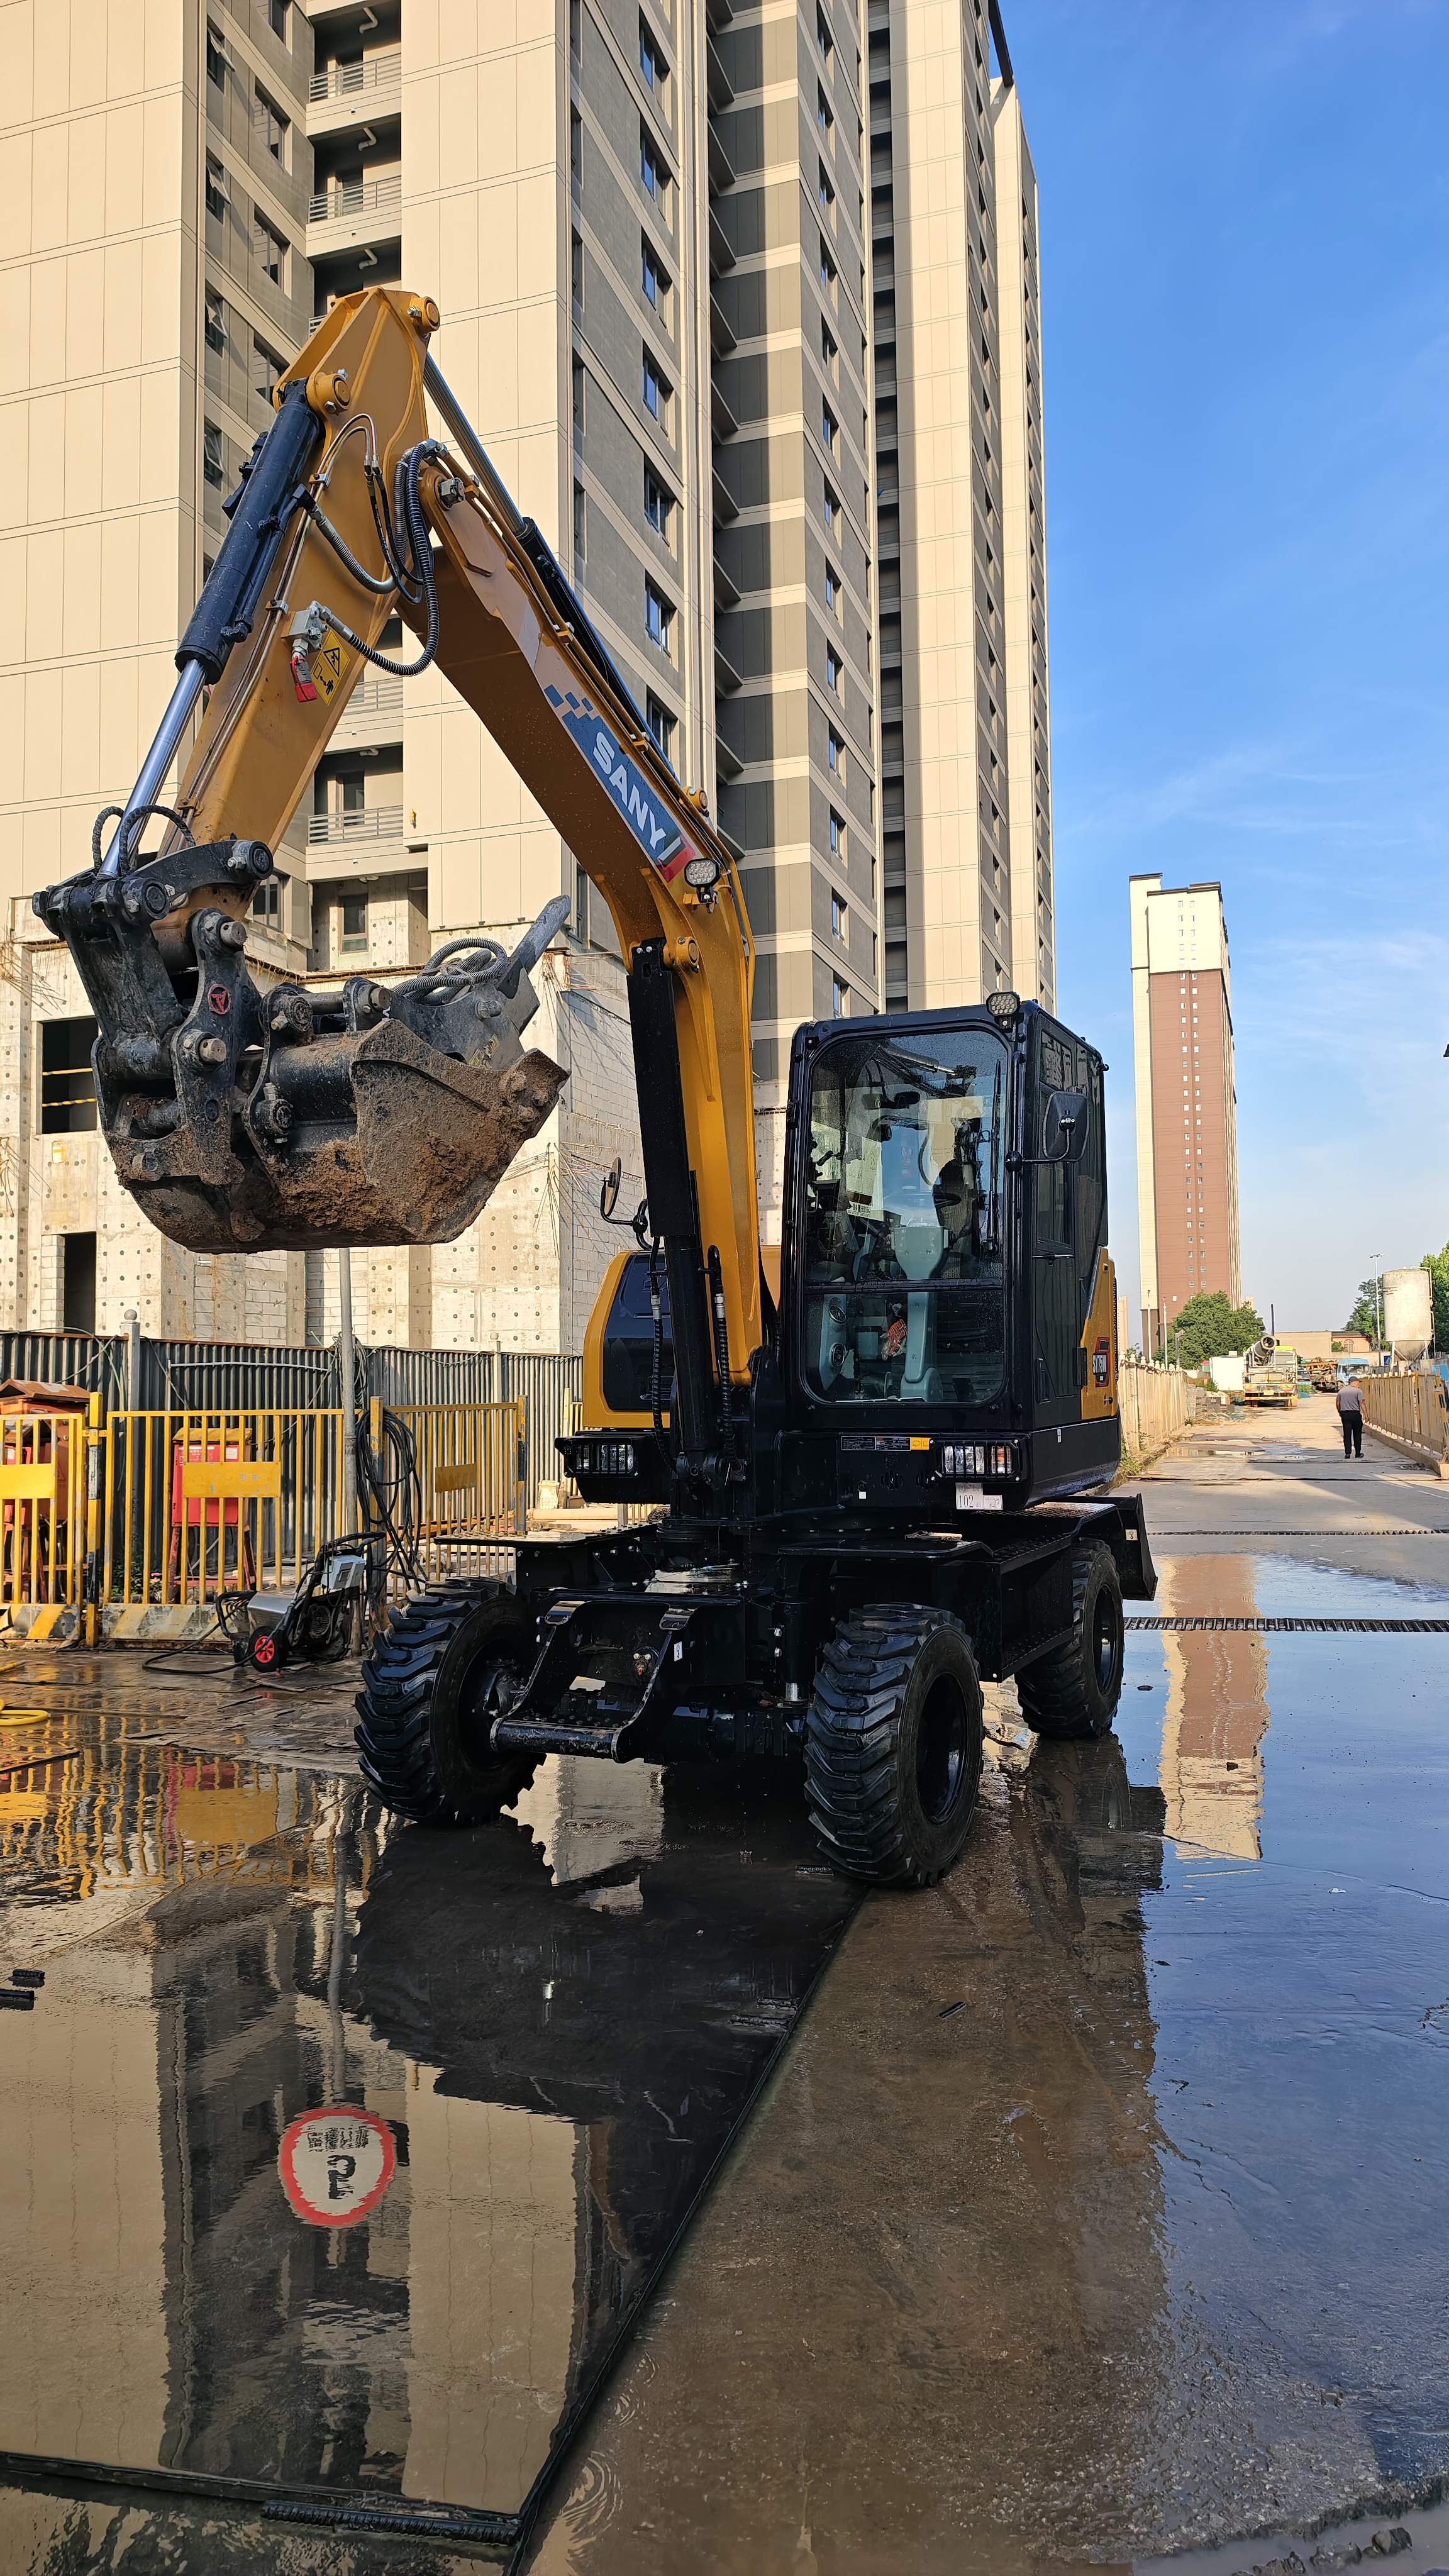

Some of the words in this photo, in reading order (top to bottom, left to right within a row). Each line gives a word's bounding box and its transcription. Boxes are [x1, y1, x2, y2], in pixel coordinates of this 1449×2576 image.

[593, 731, 666, 850] SANY
[1092, 1355, 1106, 1373] SY75W
[960, 1494, 974, 1508] 102
